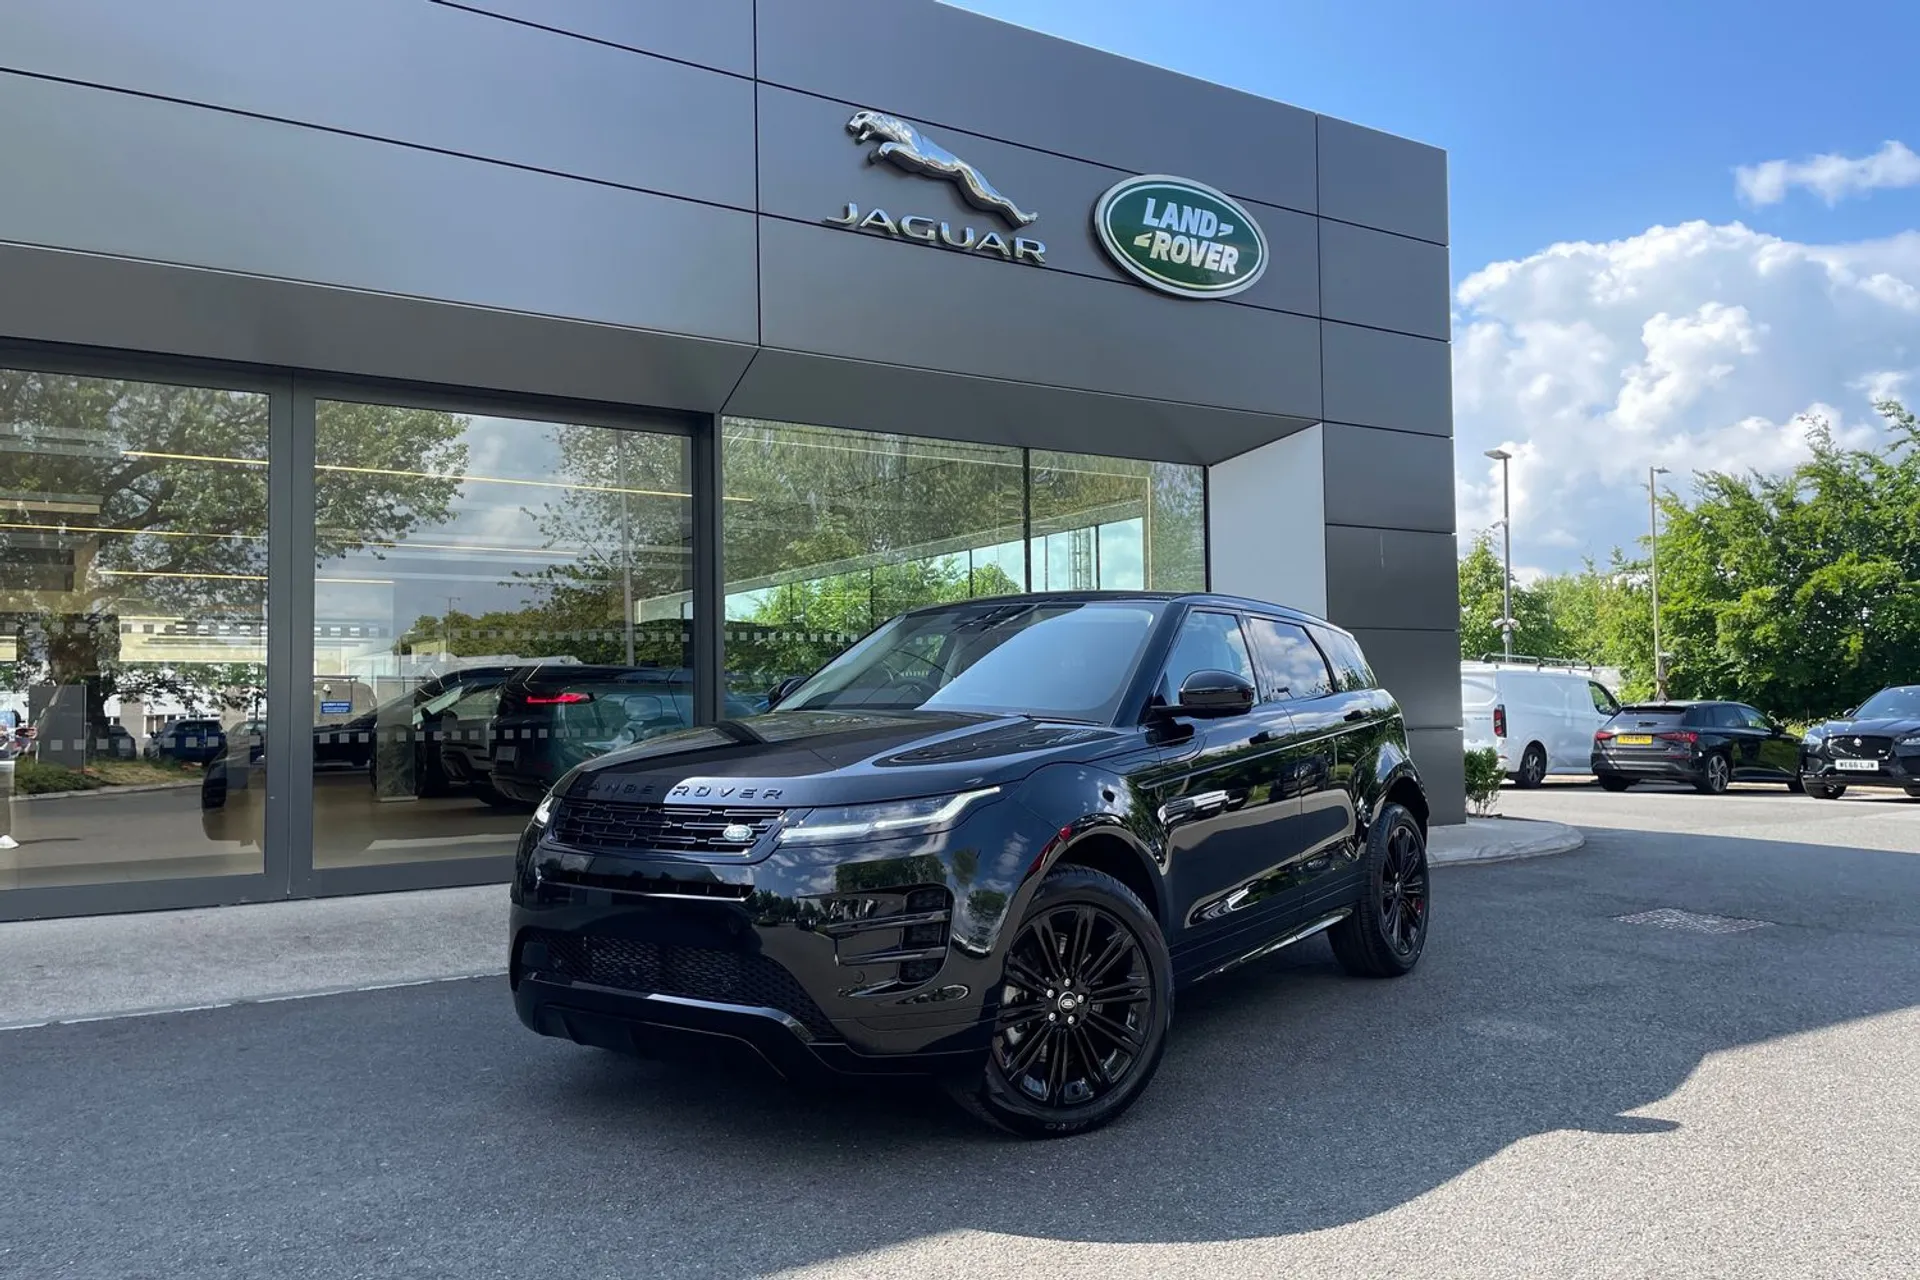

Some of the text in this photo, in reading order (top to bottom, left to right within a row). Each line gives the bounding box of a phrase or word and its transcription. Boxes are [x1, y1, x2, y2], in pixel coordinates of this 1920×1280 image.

[825, 202, 1047, 264] JAGUAR
[1143, 197, 1219, 237] LAND
[1148, 231, 1239, 275] ROVER
[575, 782, 783, 799] ANGE ROVER
